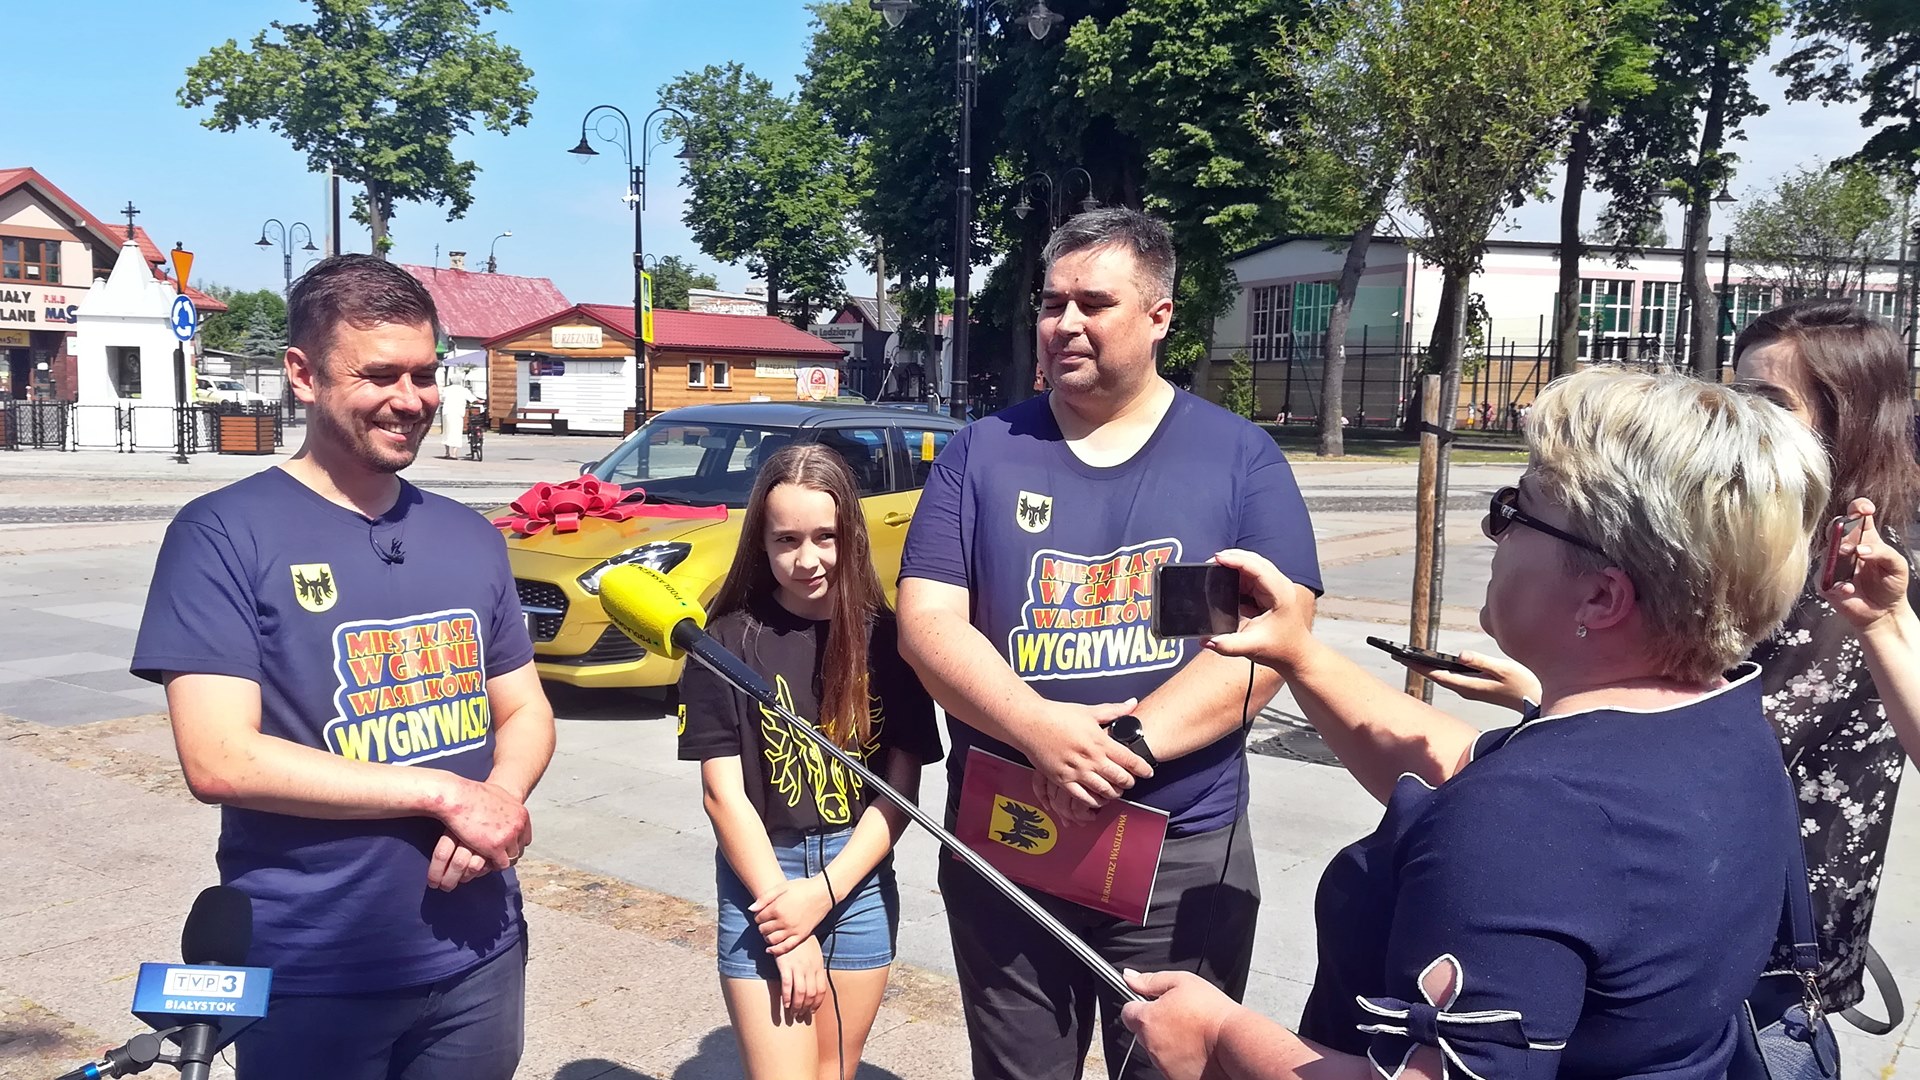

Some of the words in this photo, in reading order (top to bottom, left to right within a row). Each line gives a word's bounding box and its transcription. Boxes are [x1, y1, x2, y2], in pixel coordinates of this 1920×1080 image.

[1042, 547, 1173, 584] MIESZKASZ
[1039, 580, 1071, 605] W
[1074, 570, 1152, 606] GMINI
[345, 618, 474, 658] MIESZKASZ
[347, 654, 383, 687] W
[388, 641, 478, 680] GMINIE
[347, 670, 482, 716] WASILKÓW?
[1101, 860, 1117, 904] BURMISTRZ
[1110, 814, 1128, 861] WASILKOWA
[176, 974, 219, 990] TVP
[164, 999, 236, 1012] BIAŁYSTOK
